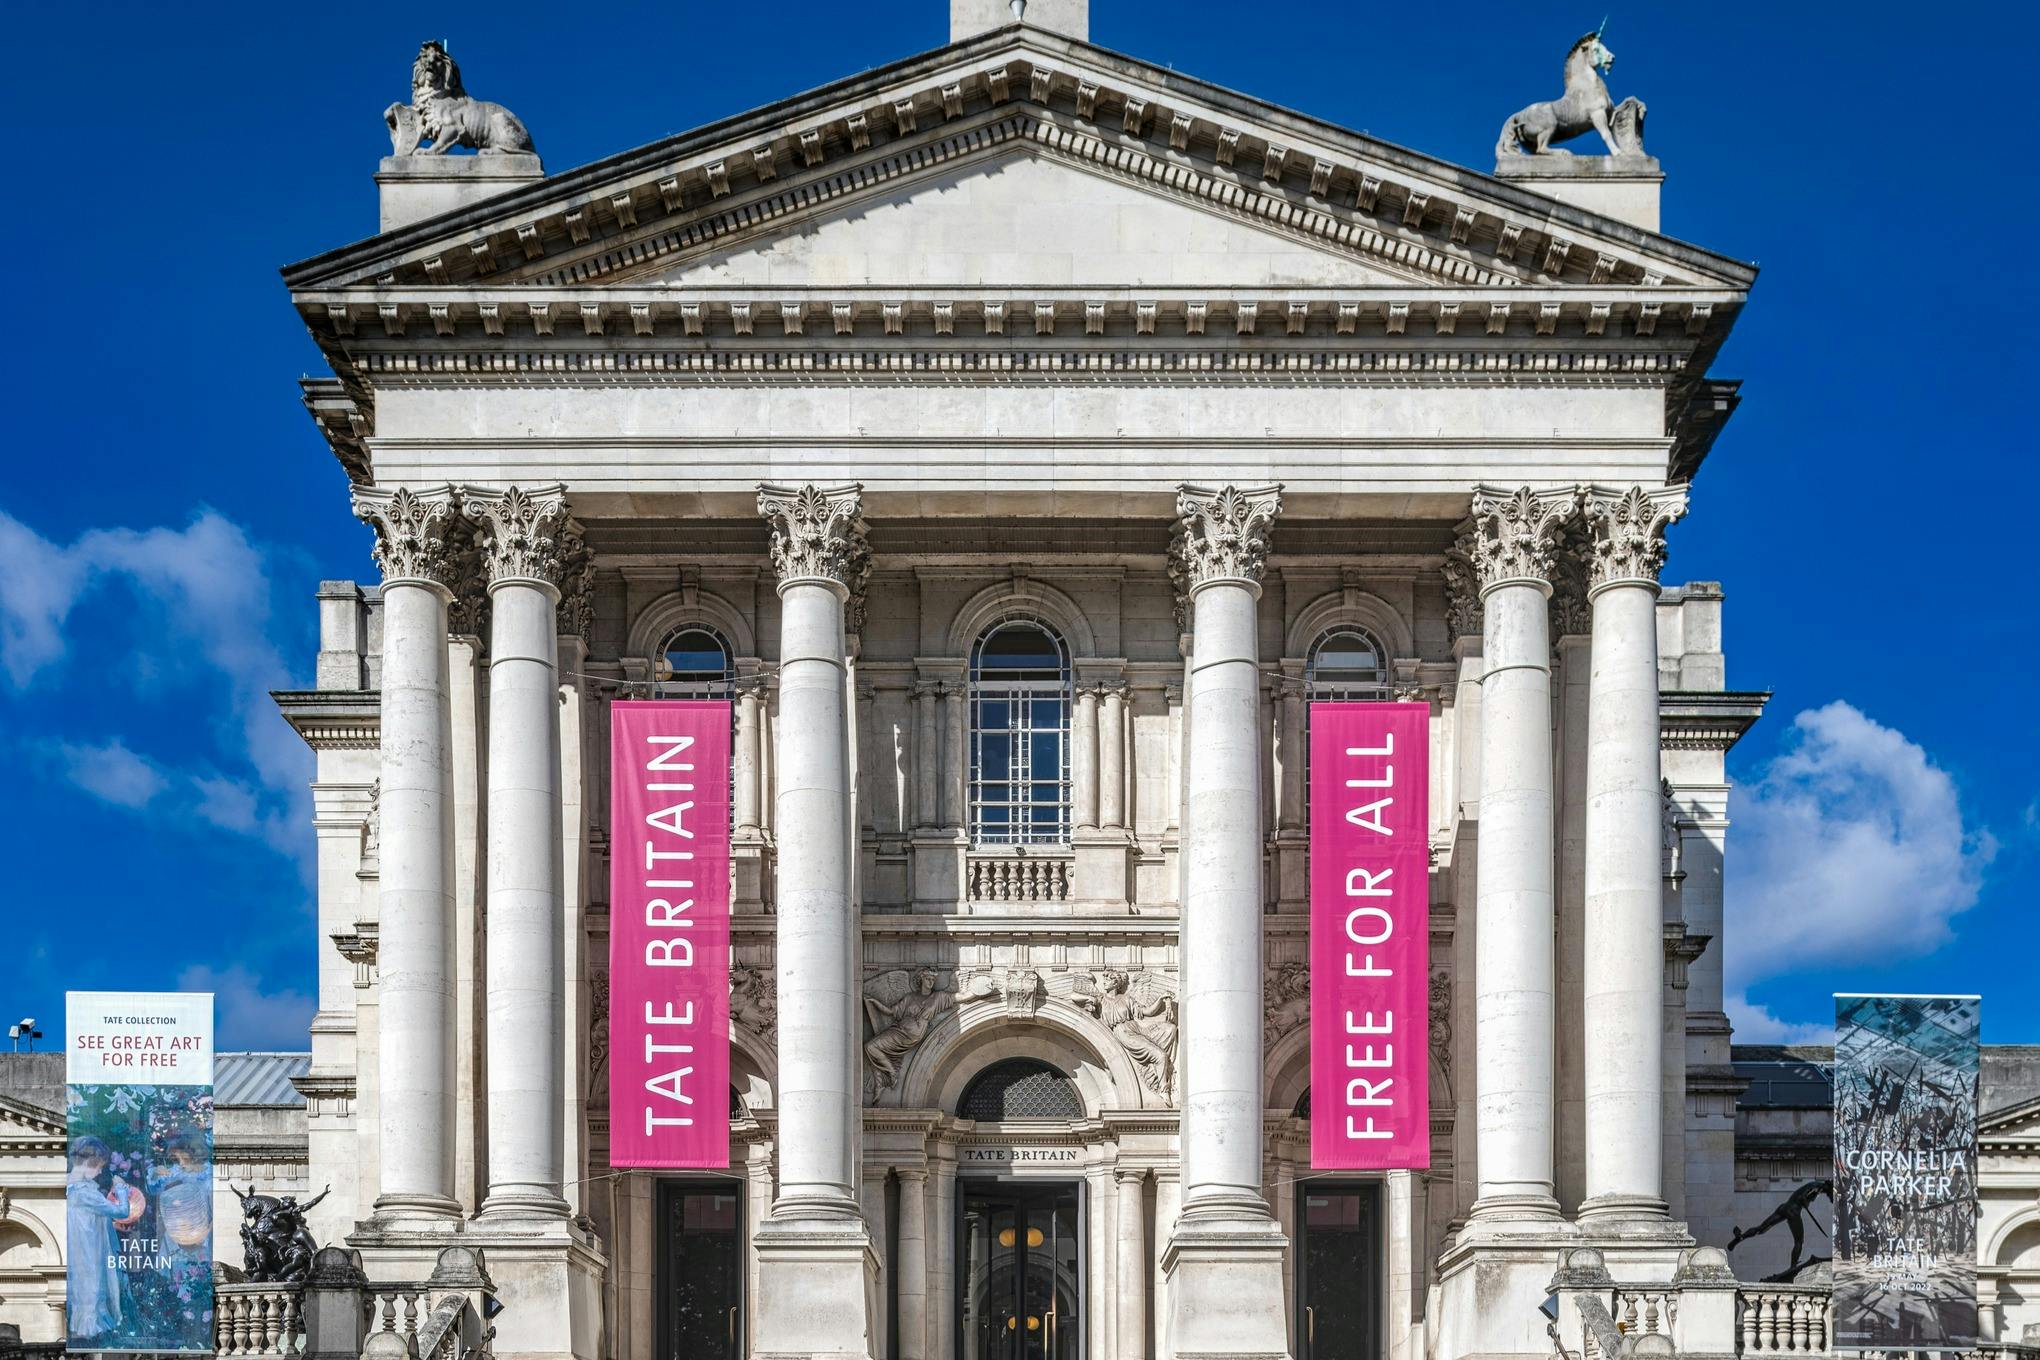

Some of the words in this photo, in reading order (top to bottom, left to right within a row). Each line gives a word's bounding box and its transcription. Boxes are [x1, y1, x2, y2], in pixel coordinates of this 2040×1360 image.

[1345, 733, 1394, 836] ALL
[645, 736, 695, 967] BRITAIN
[1345, 868, 1394, 977] FOR
[103, 1016, 123, 1025] TATE
[125, 1016, 177, 1025] COLLECTION
[78, 1035, 105, 1049] SEE
[111, 1035, 164, 1050] GREAT
[170, 1036, 202, 1050] ART
[102, 1052, 134, 1067] FOR
[140, 1053, 178, 1067] FREE
[645, 1000, 694, 1136] TATE
[1345, 1010, 1394, 1139] FREE
[965, 1150, 1005, 1160] TATE
[1010, 1150, 1077, 1160] BRITAIN
[1846, 1149, 1966, 1171] CORNELIA
[1860, 1175, 1952, 1196] PARKER
[120, 1238, 159, 1253] TATE
[1886, 1238, 1924, 1252] TATE
[107, 1255, 172, 1269] BRITAIN
[1873, 1254, 1937, 1268] BRITAIN
[1891, 1282, 1908, 1291] OCT
[1910, 1282, 1932, 1291] 2022
